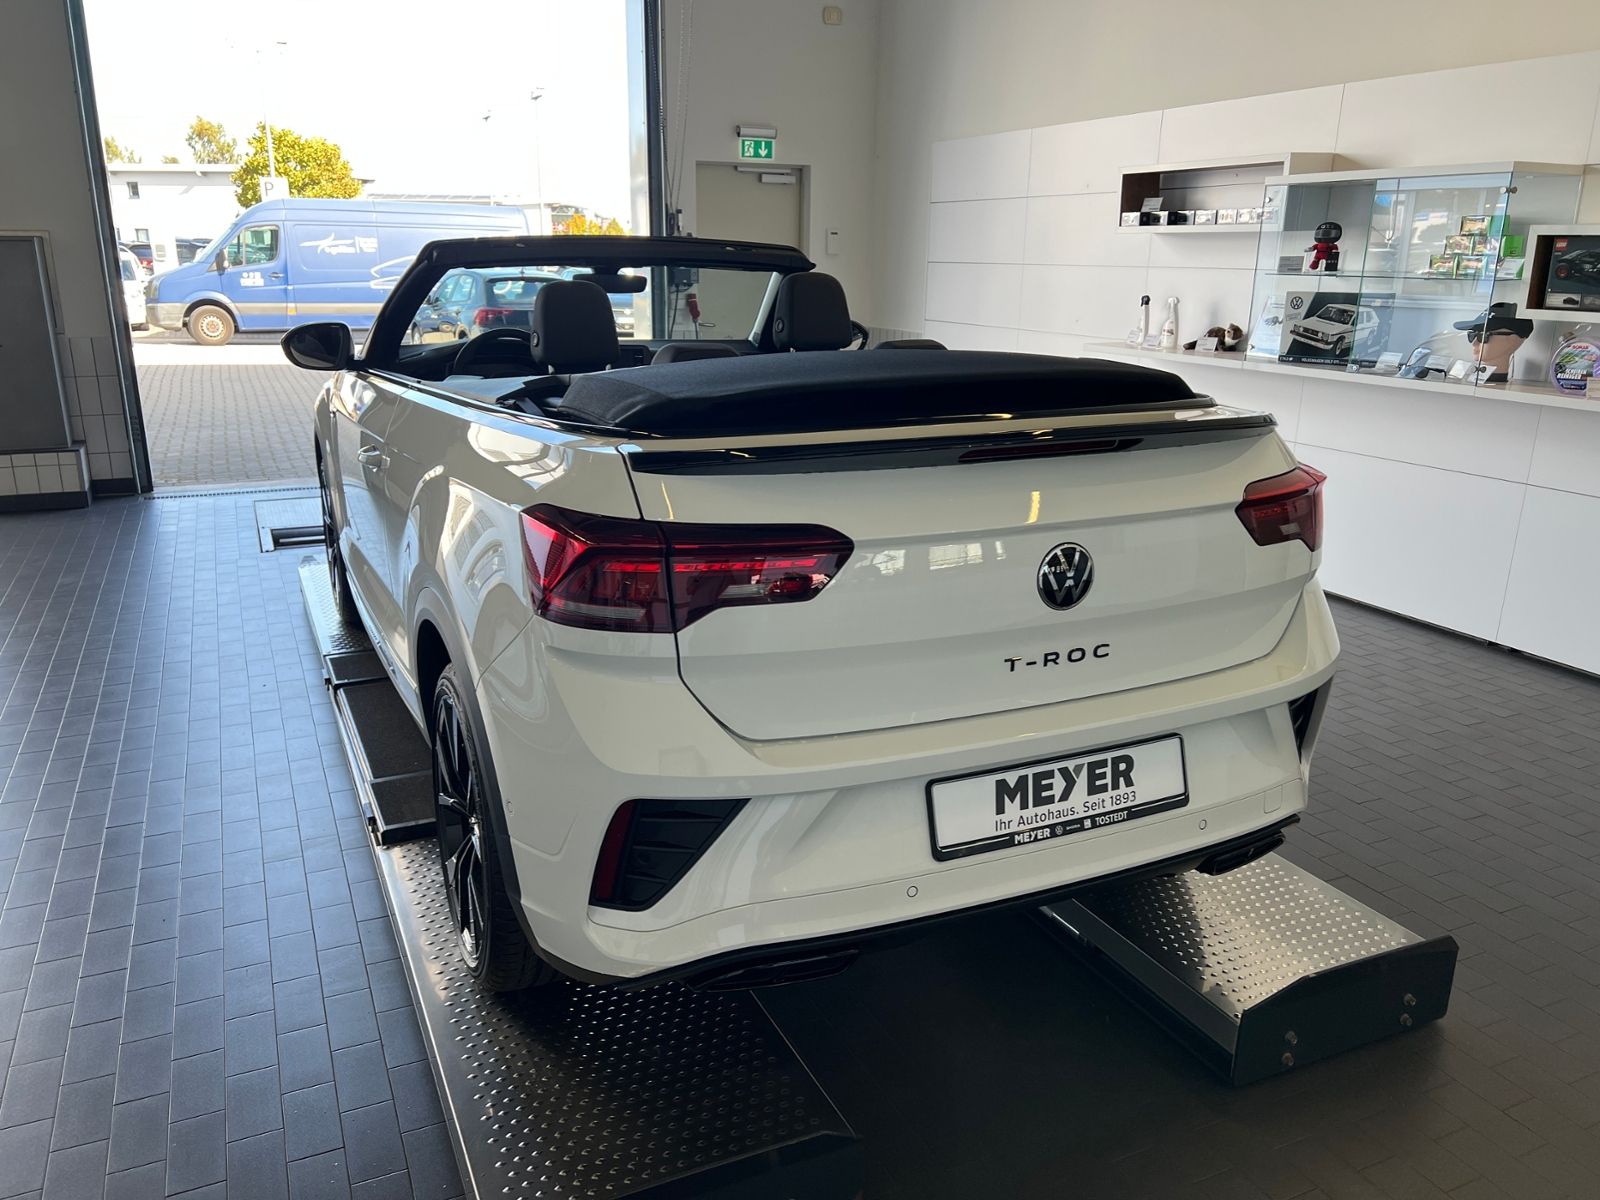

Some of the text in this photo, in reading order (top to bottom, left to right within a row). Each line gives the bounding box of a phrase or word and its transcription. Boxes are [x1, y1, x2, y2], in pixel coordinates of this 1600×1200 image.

[264, 181, 274, 197] P
[1004, 643, 1110, 672] T-ROC
[995, 753, 1135, 816] MEYER
[995, 818, 1012, 832] Ihr
[1017, 806, 1079, 829] Autohaus.
[1083, 799, 1106, 814] Seit
[1110, 791, 1137, 807] 1893
[1014, 827, 1051, 845] MEYER
[1095, 809, 1128, 826] TOSTEDT
